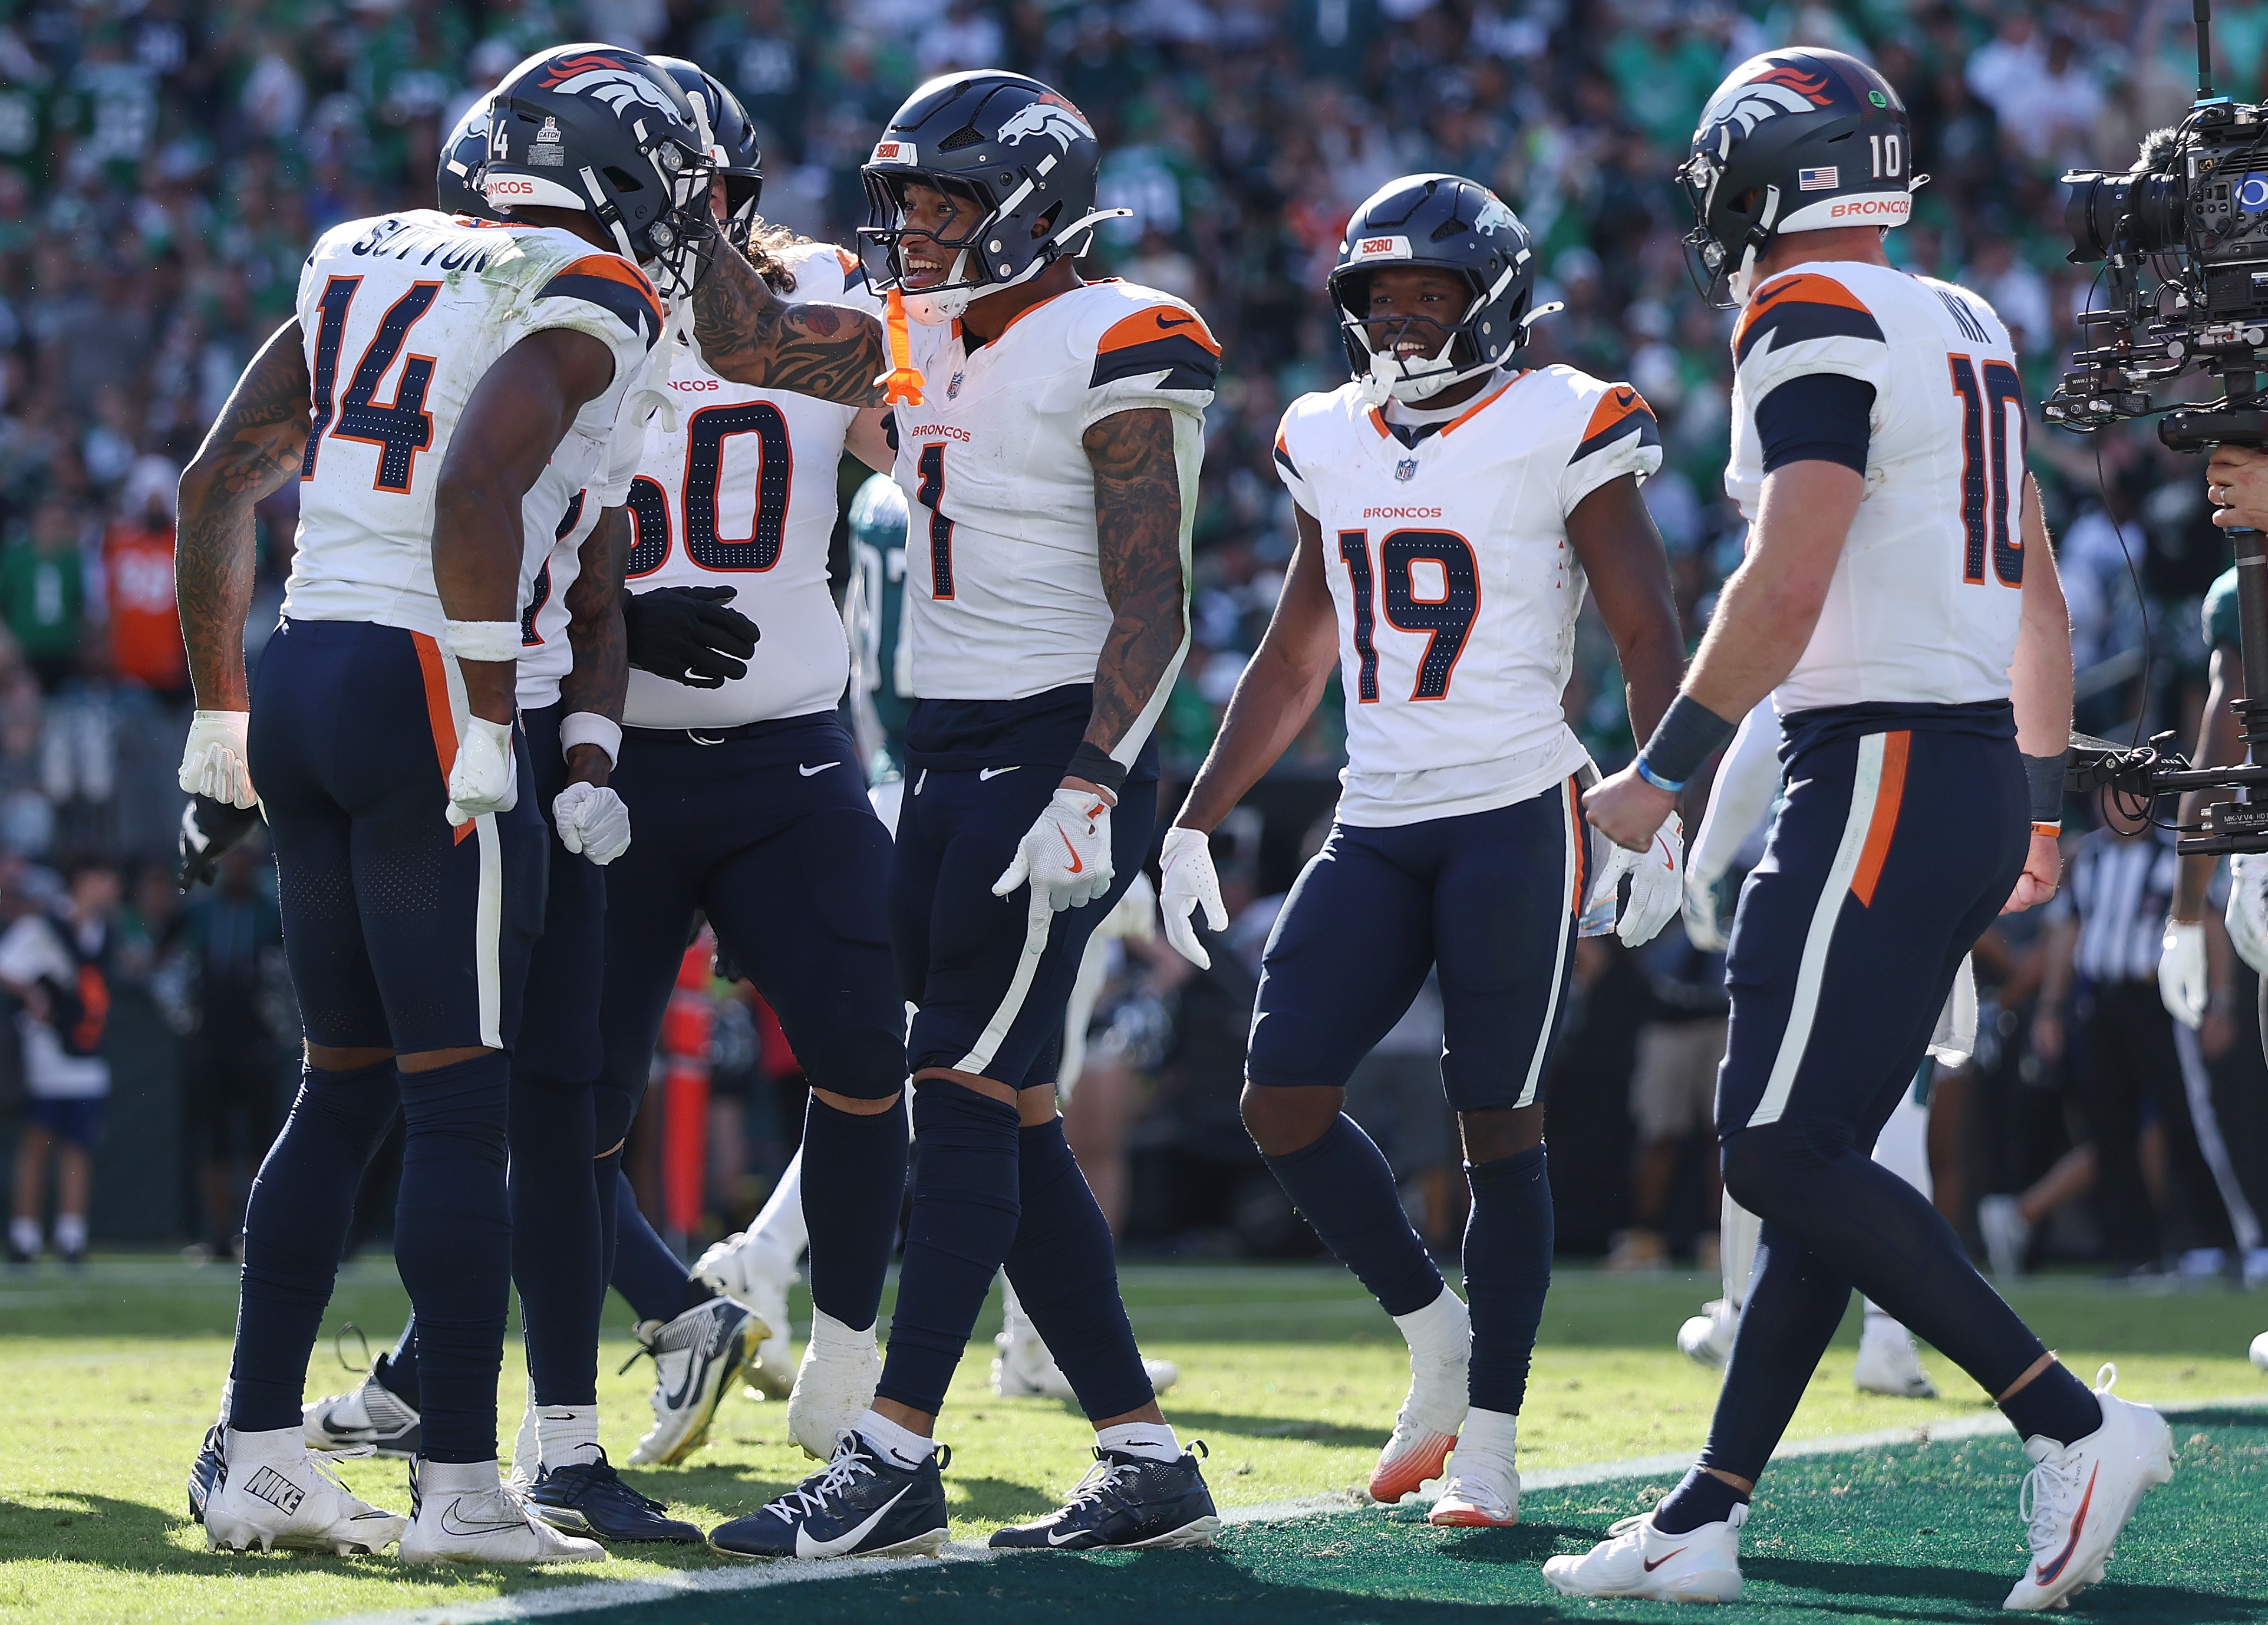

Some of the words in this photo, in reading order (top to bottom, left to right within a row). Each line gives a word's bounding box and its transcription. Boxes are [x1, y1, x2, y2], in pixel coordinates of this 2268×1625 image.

[1870, 134, 1901, 179] 10
[487, 181, 533, 196] ONCOS
[1831, 201, 1909, 218] BRONCOS
[1362, 238, 1393, 254] 5280
[301, 275, 444, 495] 14
[667, 380, 720, 393] NCOS
[912, 424, 971, 443] BRONCOS
[1946, 352, 2026, 589] 10
[917, 442, 955, 601] 1
[1363, 507, 1442, 519] BRONCOS
[1337, 528, 1482, 704] 19
[246, 1468, 304, 1514] NIKE
